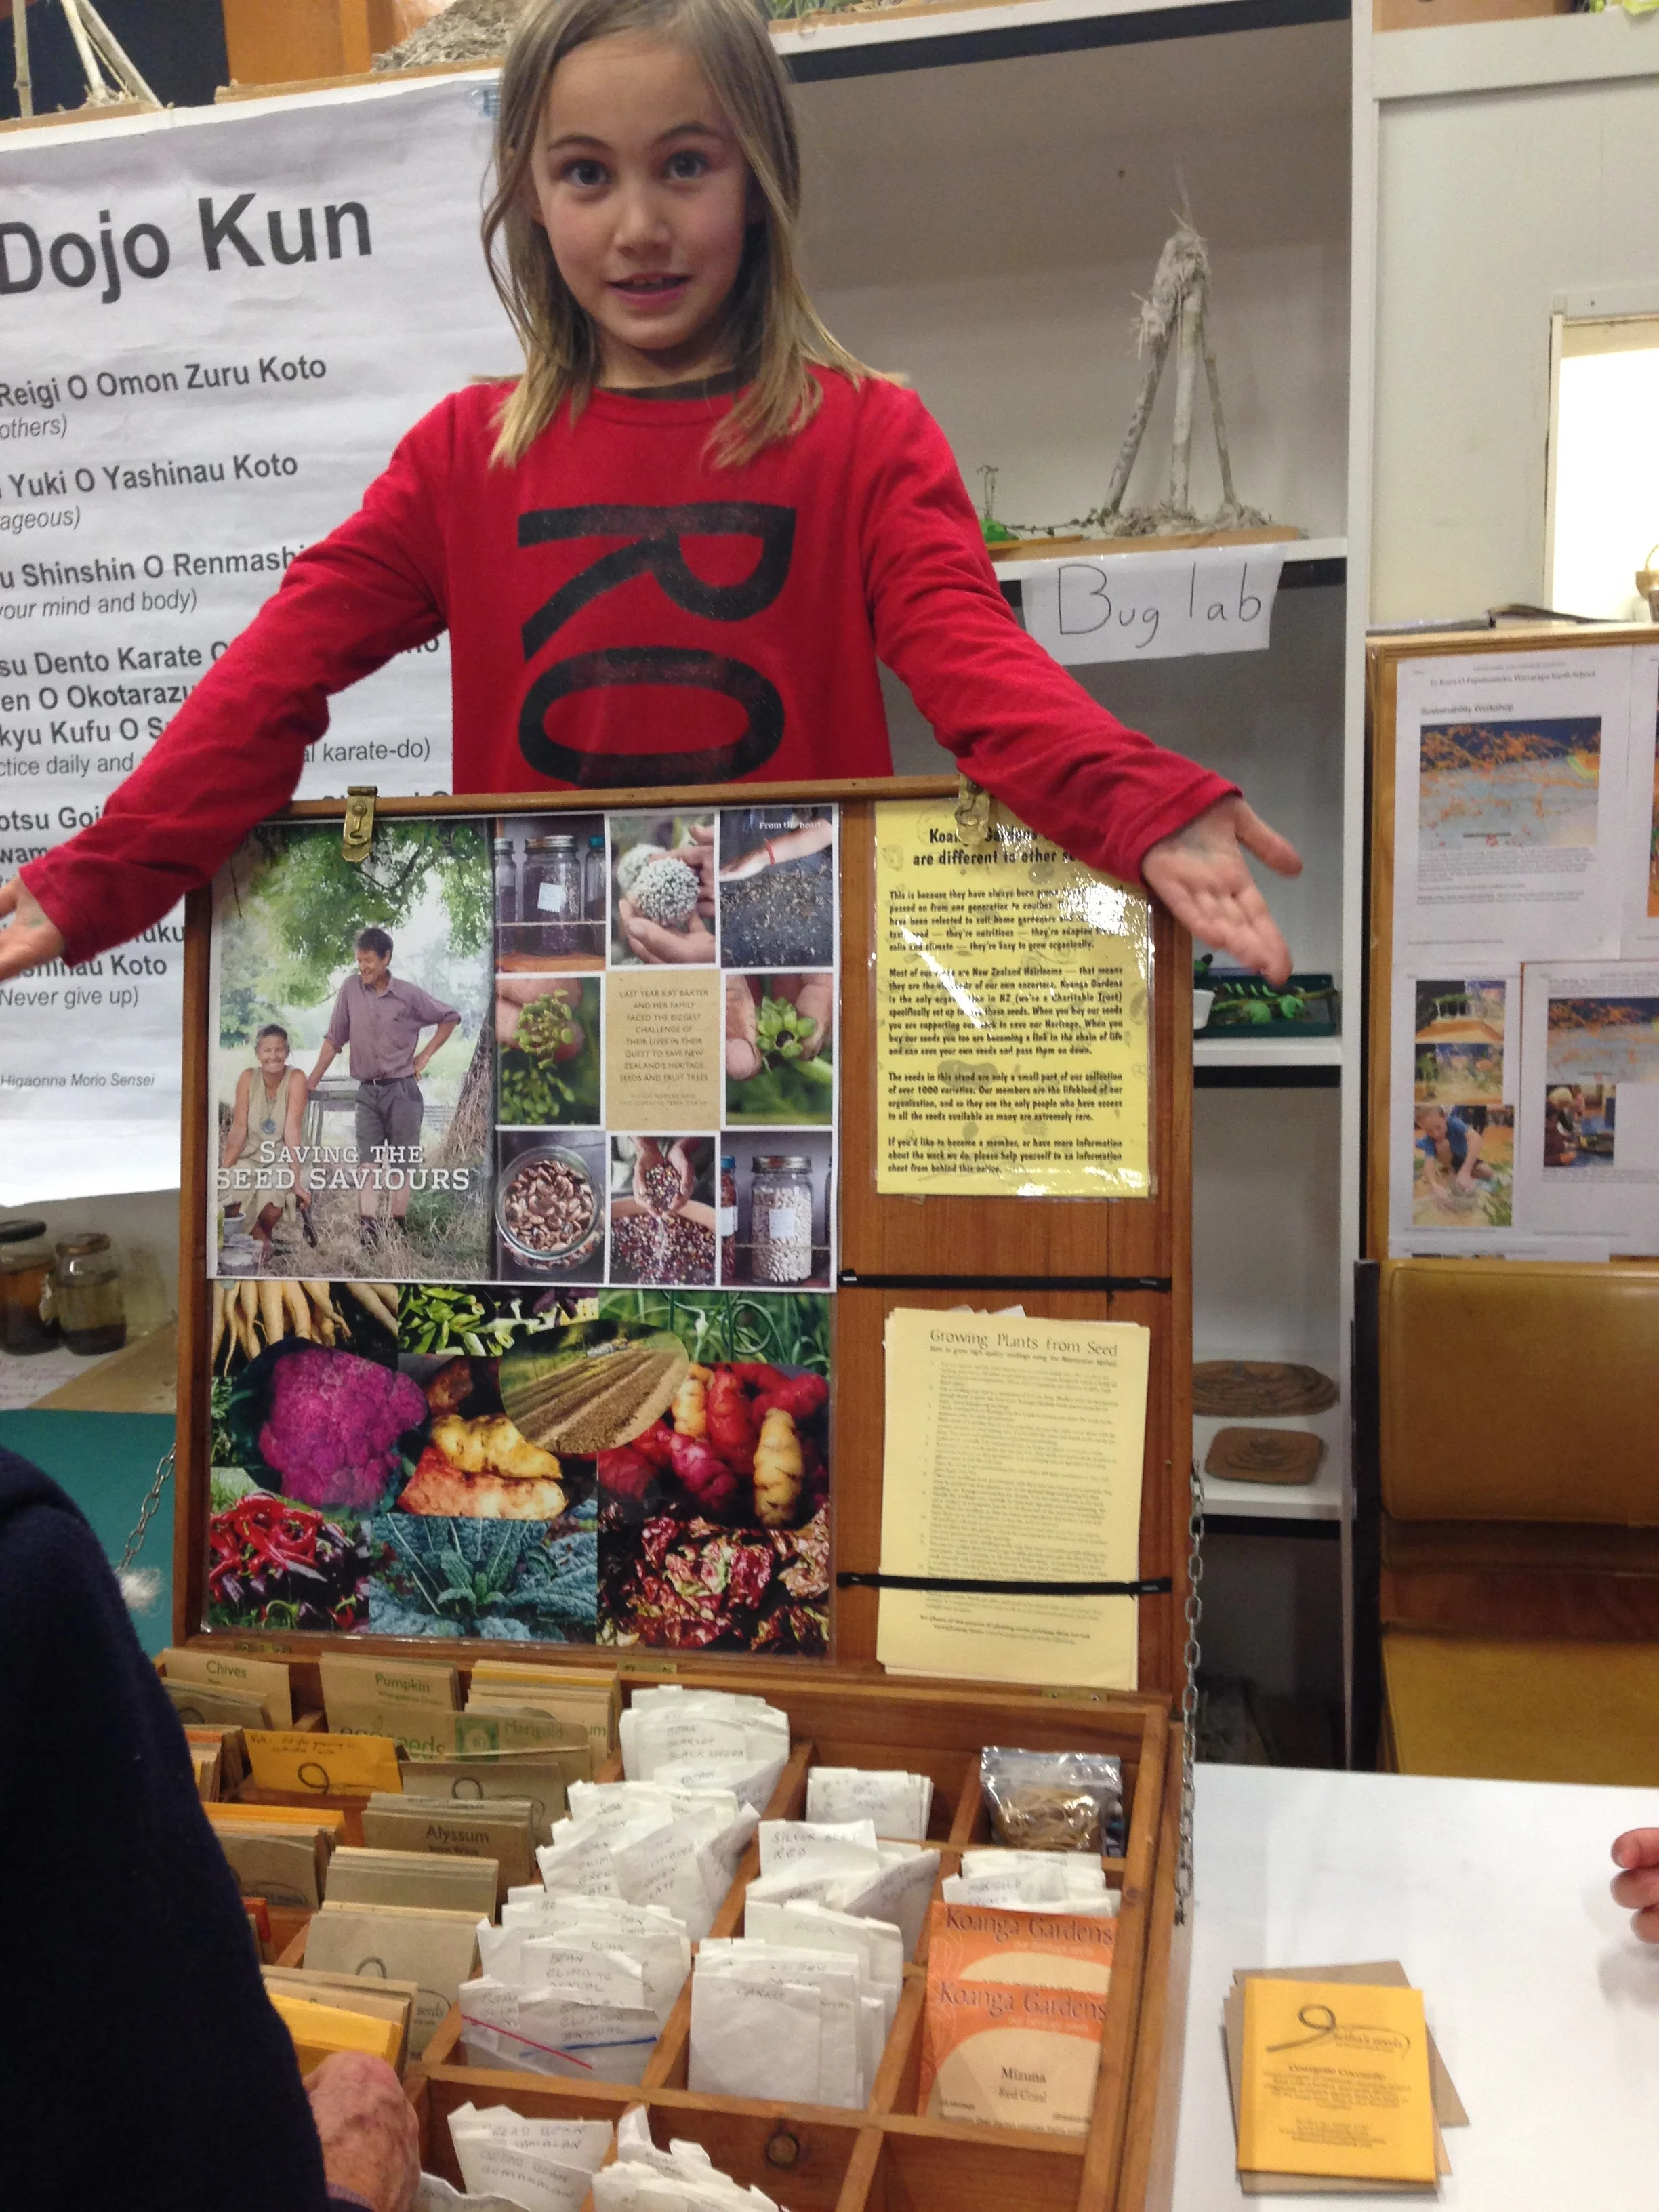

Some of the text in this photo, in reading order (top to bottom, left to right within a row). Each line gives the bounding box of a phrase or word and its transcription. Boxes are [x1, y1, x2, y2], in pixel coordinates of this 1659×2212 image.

[0, 193, 371, 304] Dojo Kun
[0, 356, 326, 408] Reigi O Omon Zuru Koto
[0, 414, 66, 439] others)
[8, 453, 298, 499] Yuki O Yashinau Koto
[22, 558, 135, 587] Shinshin
[144, 555, 163, 578] O
[173, 544, 304, 577] Renmash
[42, 596, 90, 617] mind
[98, 592, 134, 614] and
[142, 587, 197, 614] body)
[1059, 562, 1261, 649] Bug lab
[35, 651, 109, 675] Dento
[118, 645, 202, 670] Karate
[39, 687, 58, 709] O
[50, 720, 110, 744] Kufu
[119, 718, 139, 740] O
[323, 737, 430, 762] karate-do)
[46, 754, 90, 777] daily
[98, 752, 134, 772] and
[914, 855, 933, 865] are
[939, 850, 998, 865] different
[1021, 848, 1056, 863] other
[949, 889, 965, 901] they
[968, 888, 985, 898] have
[110, 955, 167, 975] Koto
[65, 987, 102, 1009] give
[110, 986, 138, 1008] up)
[71, 1073, 106, 1086] Morio
[110, 1073, 155, 1086] Sensei
[888, 1072, 901, 1082] The
[905, 1072, 924, 1081] seeds
[937, 1072, 951, 1081] this
[954, 1072, 975, 1081] stand
[992, 1072, 1008, 1084] only
[1018, 1071, 1038, 1081] small
[1041, 1073, 1057, 1083] part
[1085, 1071, 1122, 1081] collection
[918, 1086, 938, 1094] 1000
[979, 1086, 992, 1094] Our
[996, 1085, 1030, 1094] members
[1048, 1084, 1060, 1094] the
[1063, 1084, 1097, 1094] lifeblood
[1076, 1137, 1122, 1147] information
[370, 1145, 423, 1164] THE
[975, 1151, 998, 1162] please
[1020, 1151, 1051, 1162] yourself
[217, 1168, 470, 1191] SEED SAVIOURS
[930, 1329, 987, 1350] Growing
[998, 1333, 1038, 1349] Plants
[1046, 1337, 1080, 1353] from
[1087, 1340, 1118, 1356] Seed
[206, 1660, 247, 1679] Chives
[375, 1673, 430, 1694] Pumpkin
[504, 1718, 563, 1741] Marigold
[426, 1824, 489, 1844] Alyssum
[947, 1907, 1115, 1945] Koanga Gardens
[941, 1981, 1106, 2020] Koanga Gardens
[1001, 2066, 1046, 2083] Mizuna
